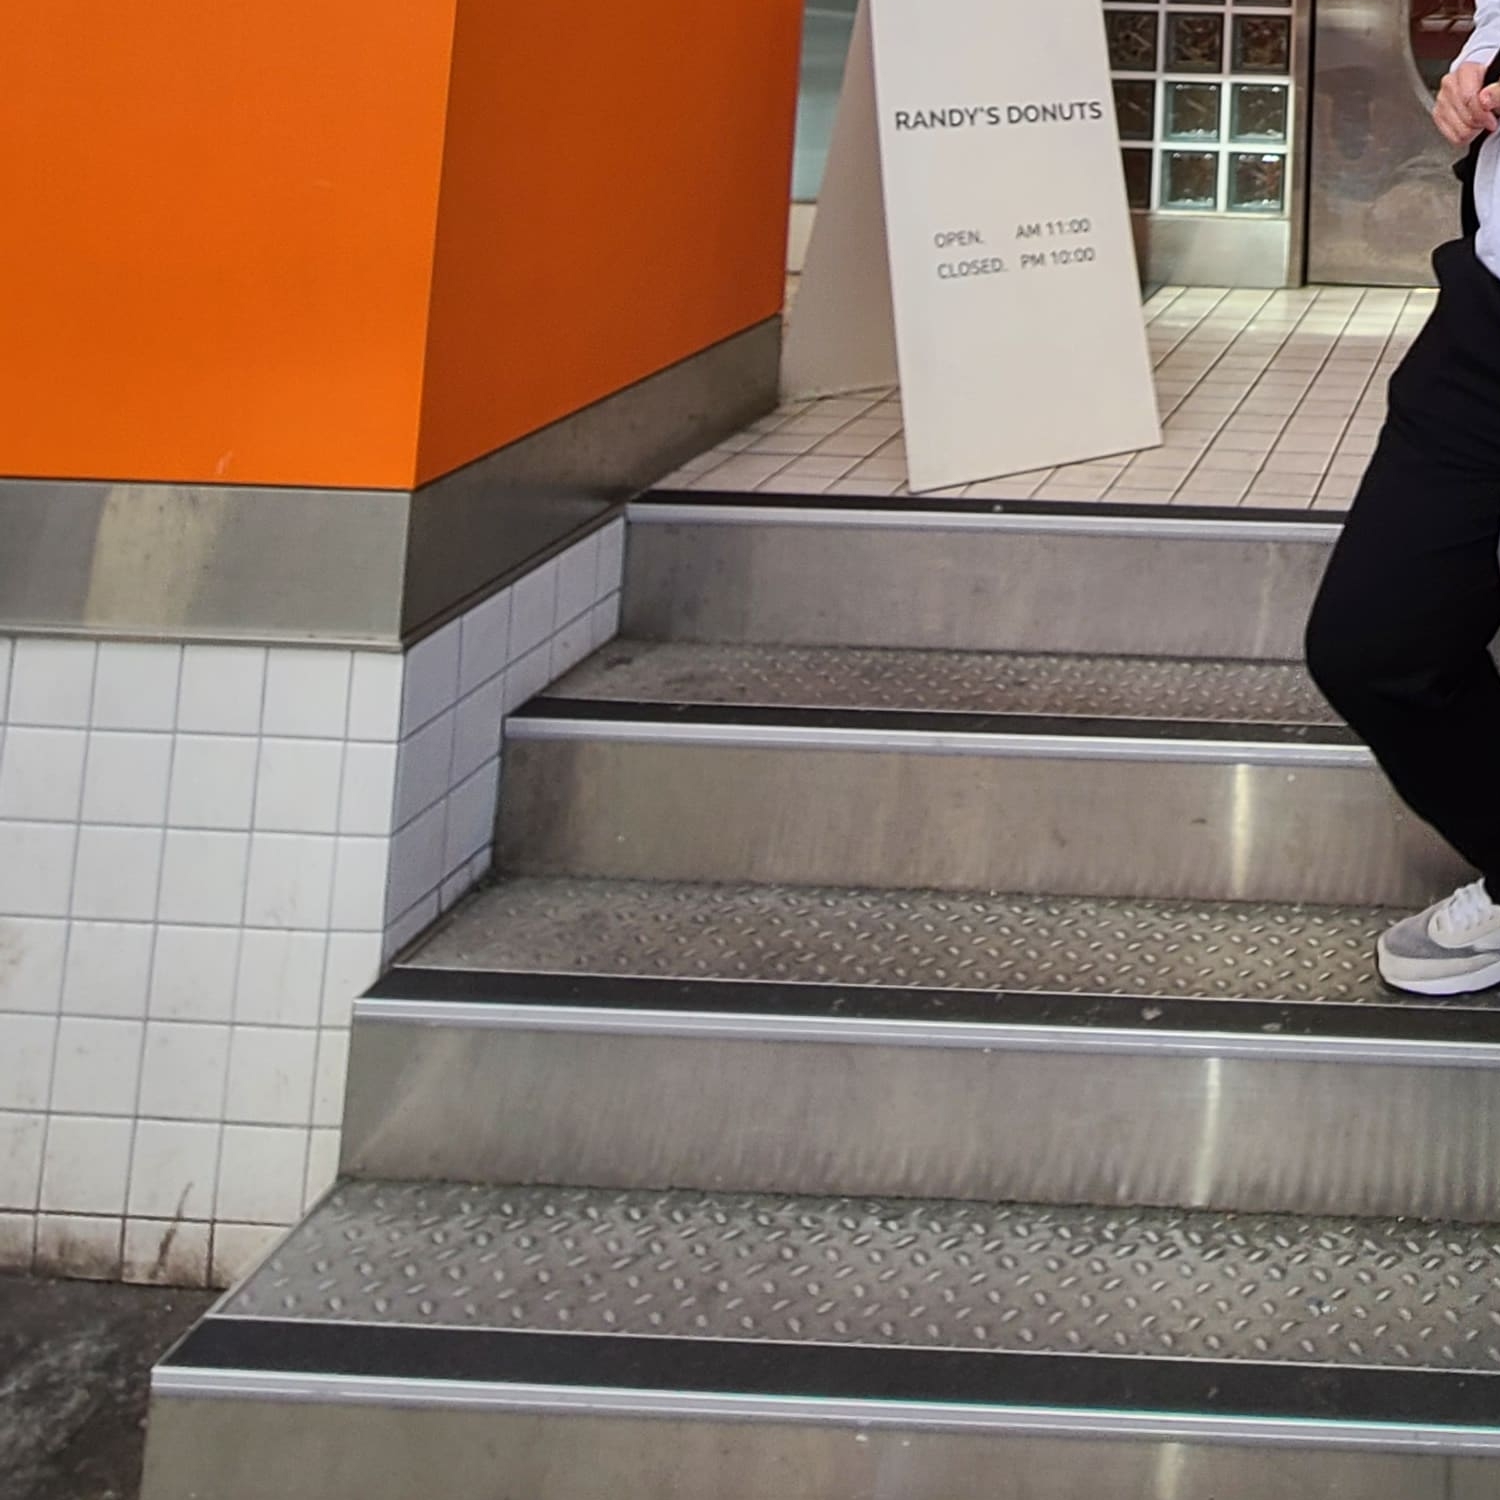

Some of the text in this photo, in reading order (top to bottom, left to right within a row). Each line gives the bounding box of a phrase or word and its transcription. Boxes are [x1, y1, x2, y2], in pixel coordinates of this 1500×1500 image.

[895, 101, 1103, 130] RANDY'S DONUTS
[1015, 222, 1042, 241] AM
[1046, 218, 1090, 236] 11:00
[1021, 251, 1046, 268] PM
[1050, 247, 1095, 265] 10:00
